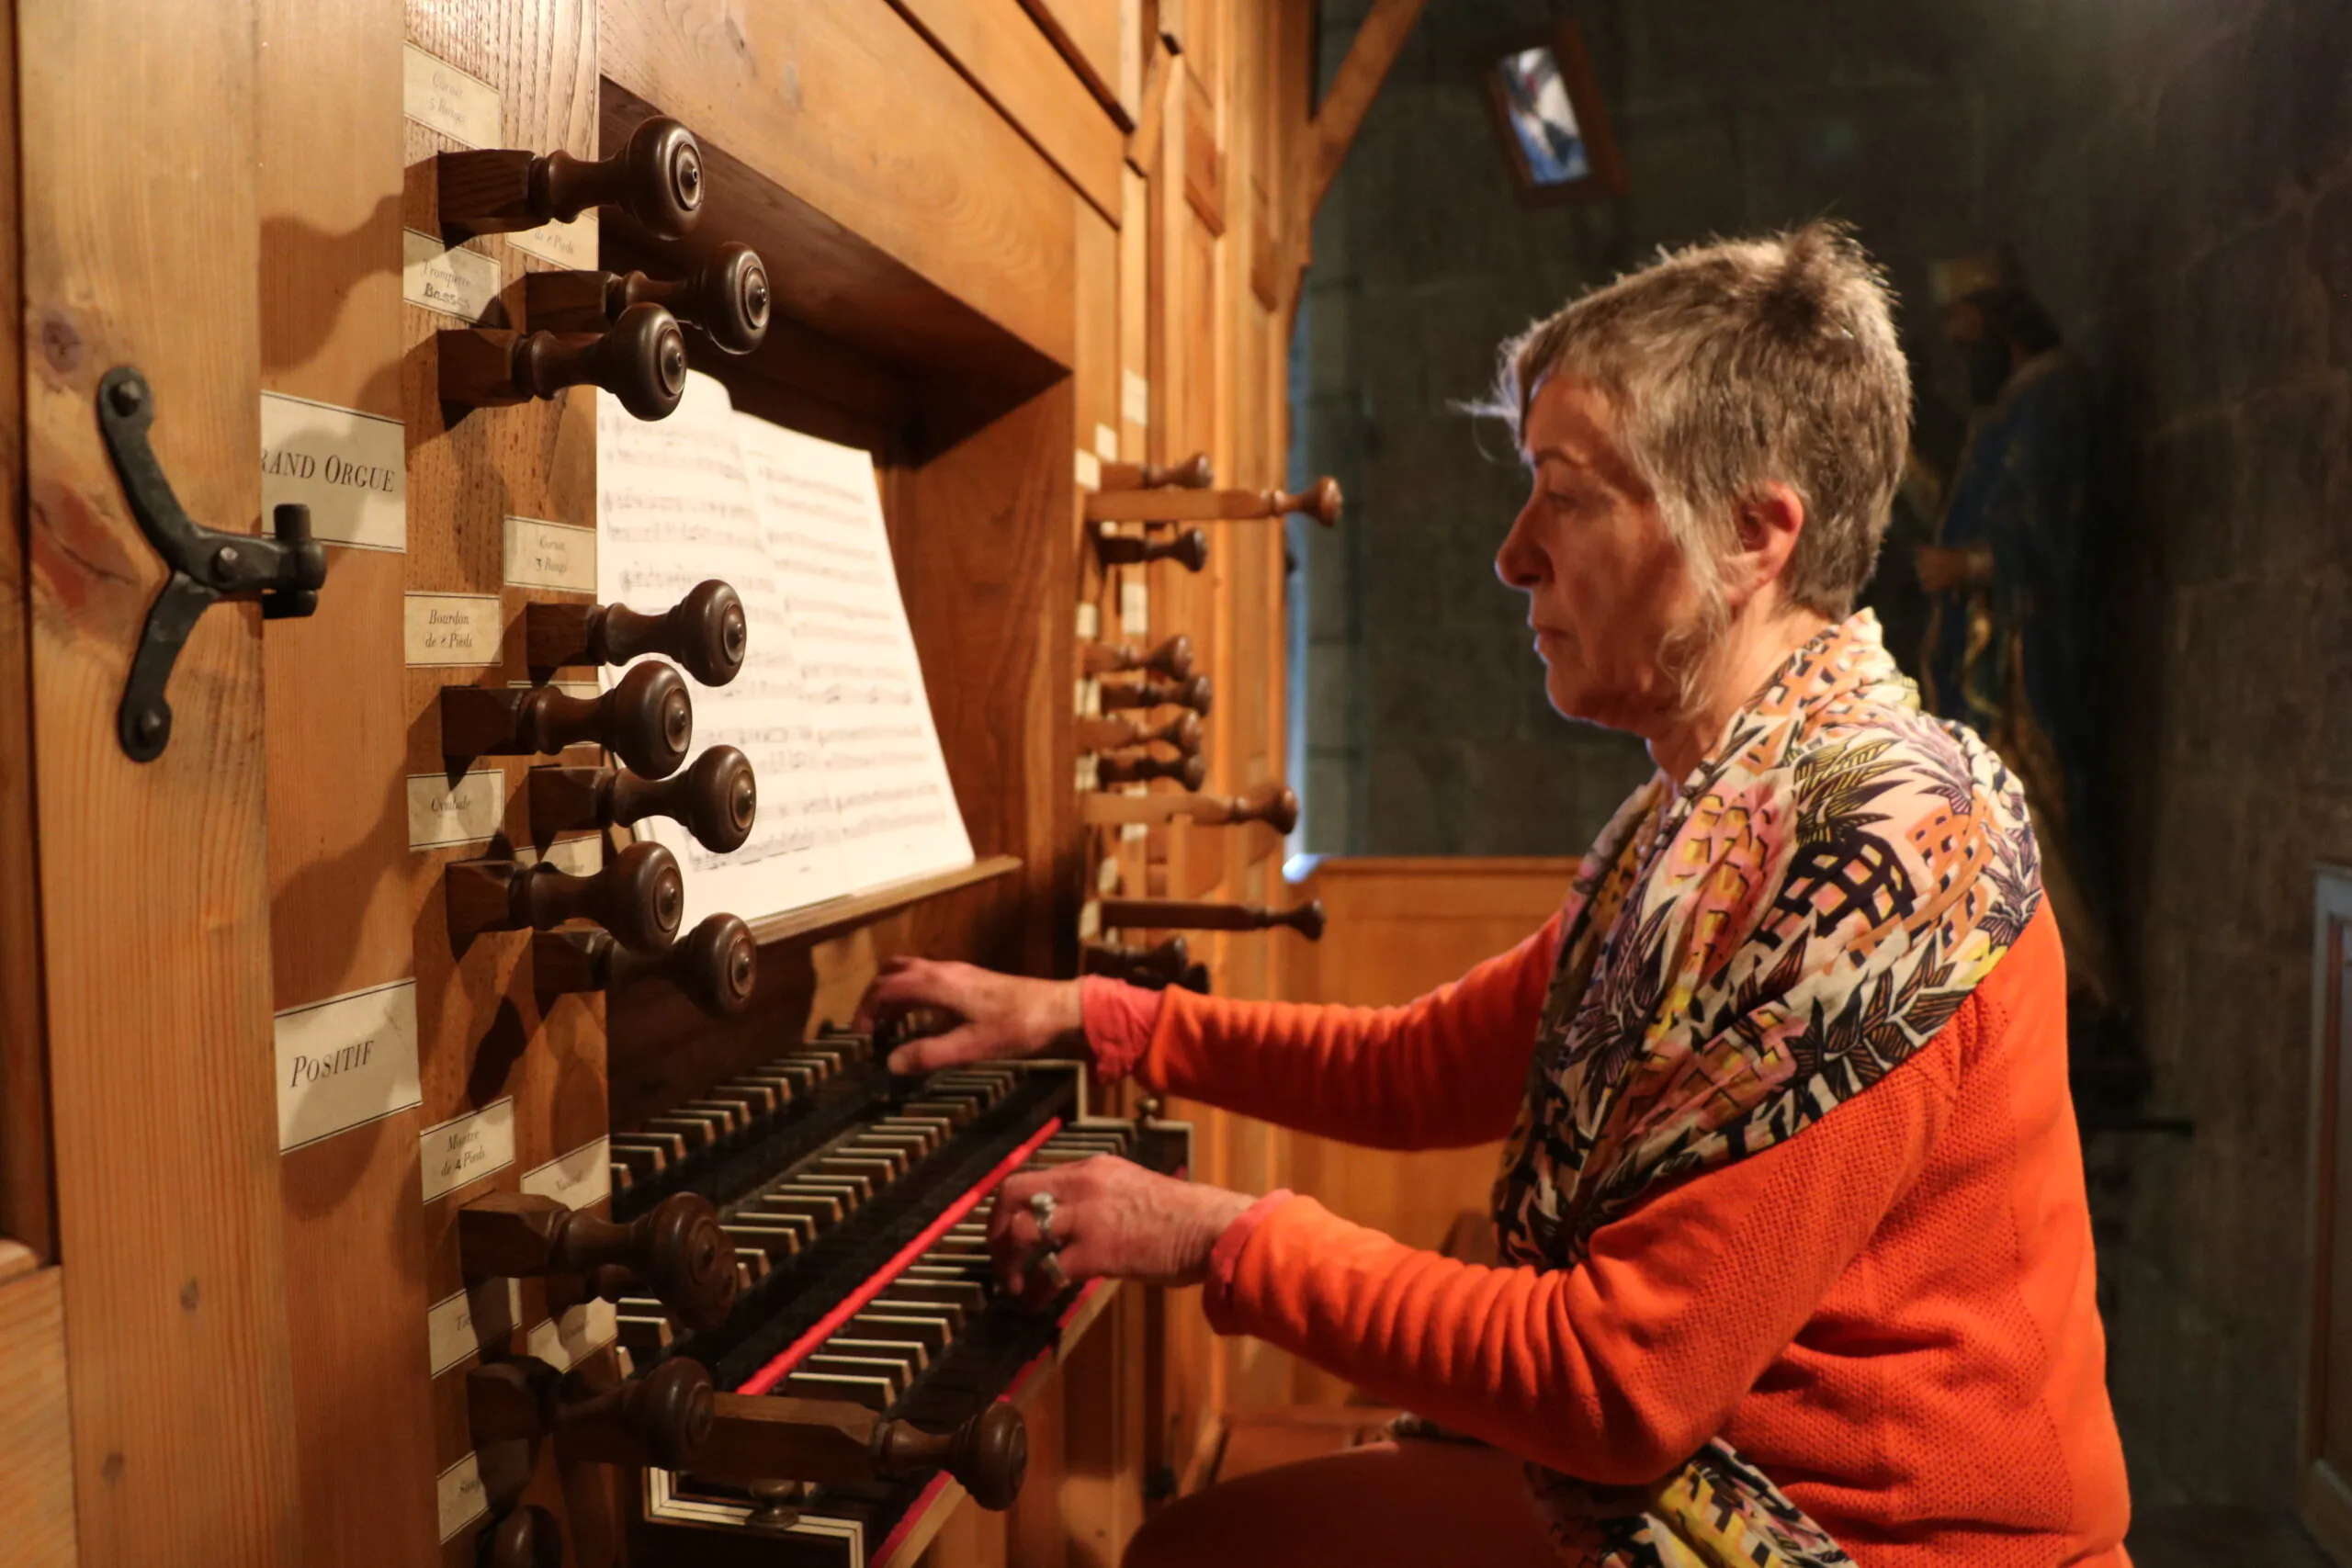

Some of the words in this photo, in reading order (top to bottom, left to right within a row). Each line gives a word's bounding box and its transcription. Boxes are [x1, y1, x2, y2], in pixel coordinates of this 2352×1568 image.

[261, 449, 316, 479] RAND
[324, 454, 395, 492] ORGUE
[427, 608, 469, 626] Bourdon
[424, 632, 437, 649] de
[448, 632, 473, 649] Pieds
[289, 1040, 375, 1089] POSITIF
[455, 1158, 462, 1169] 4
